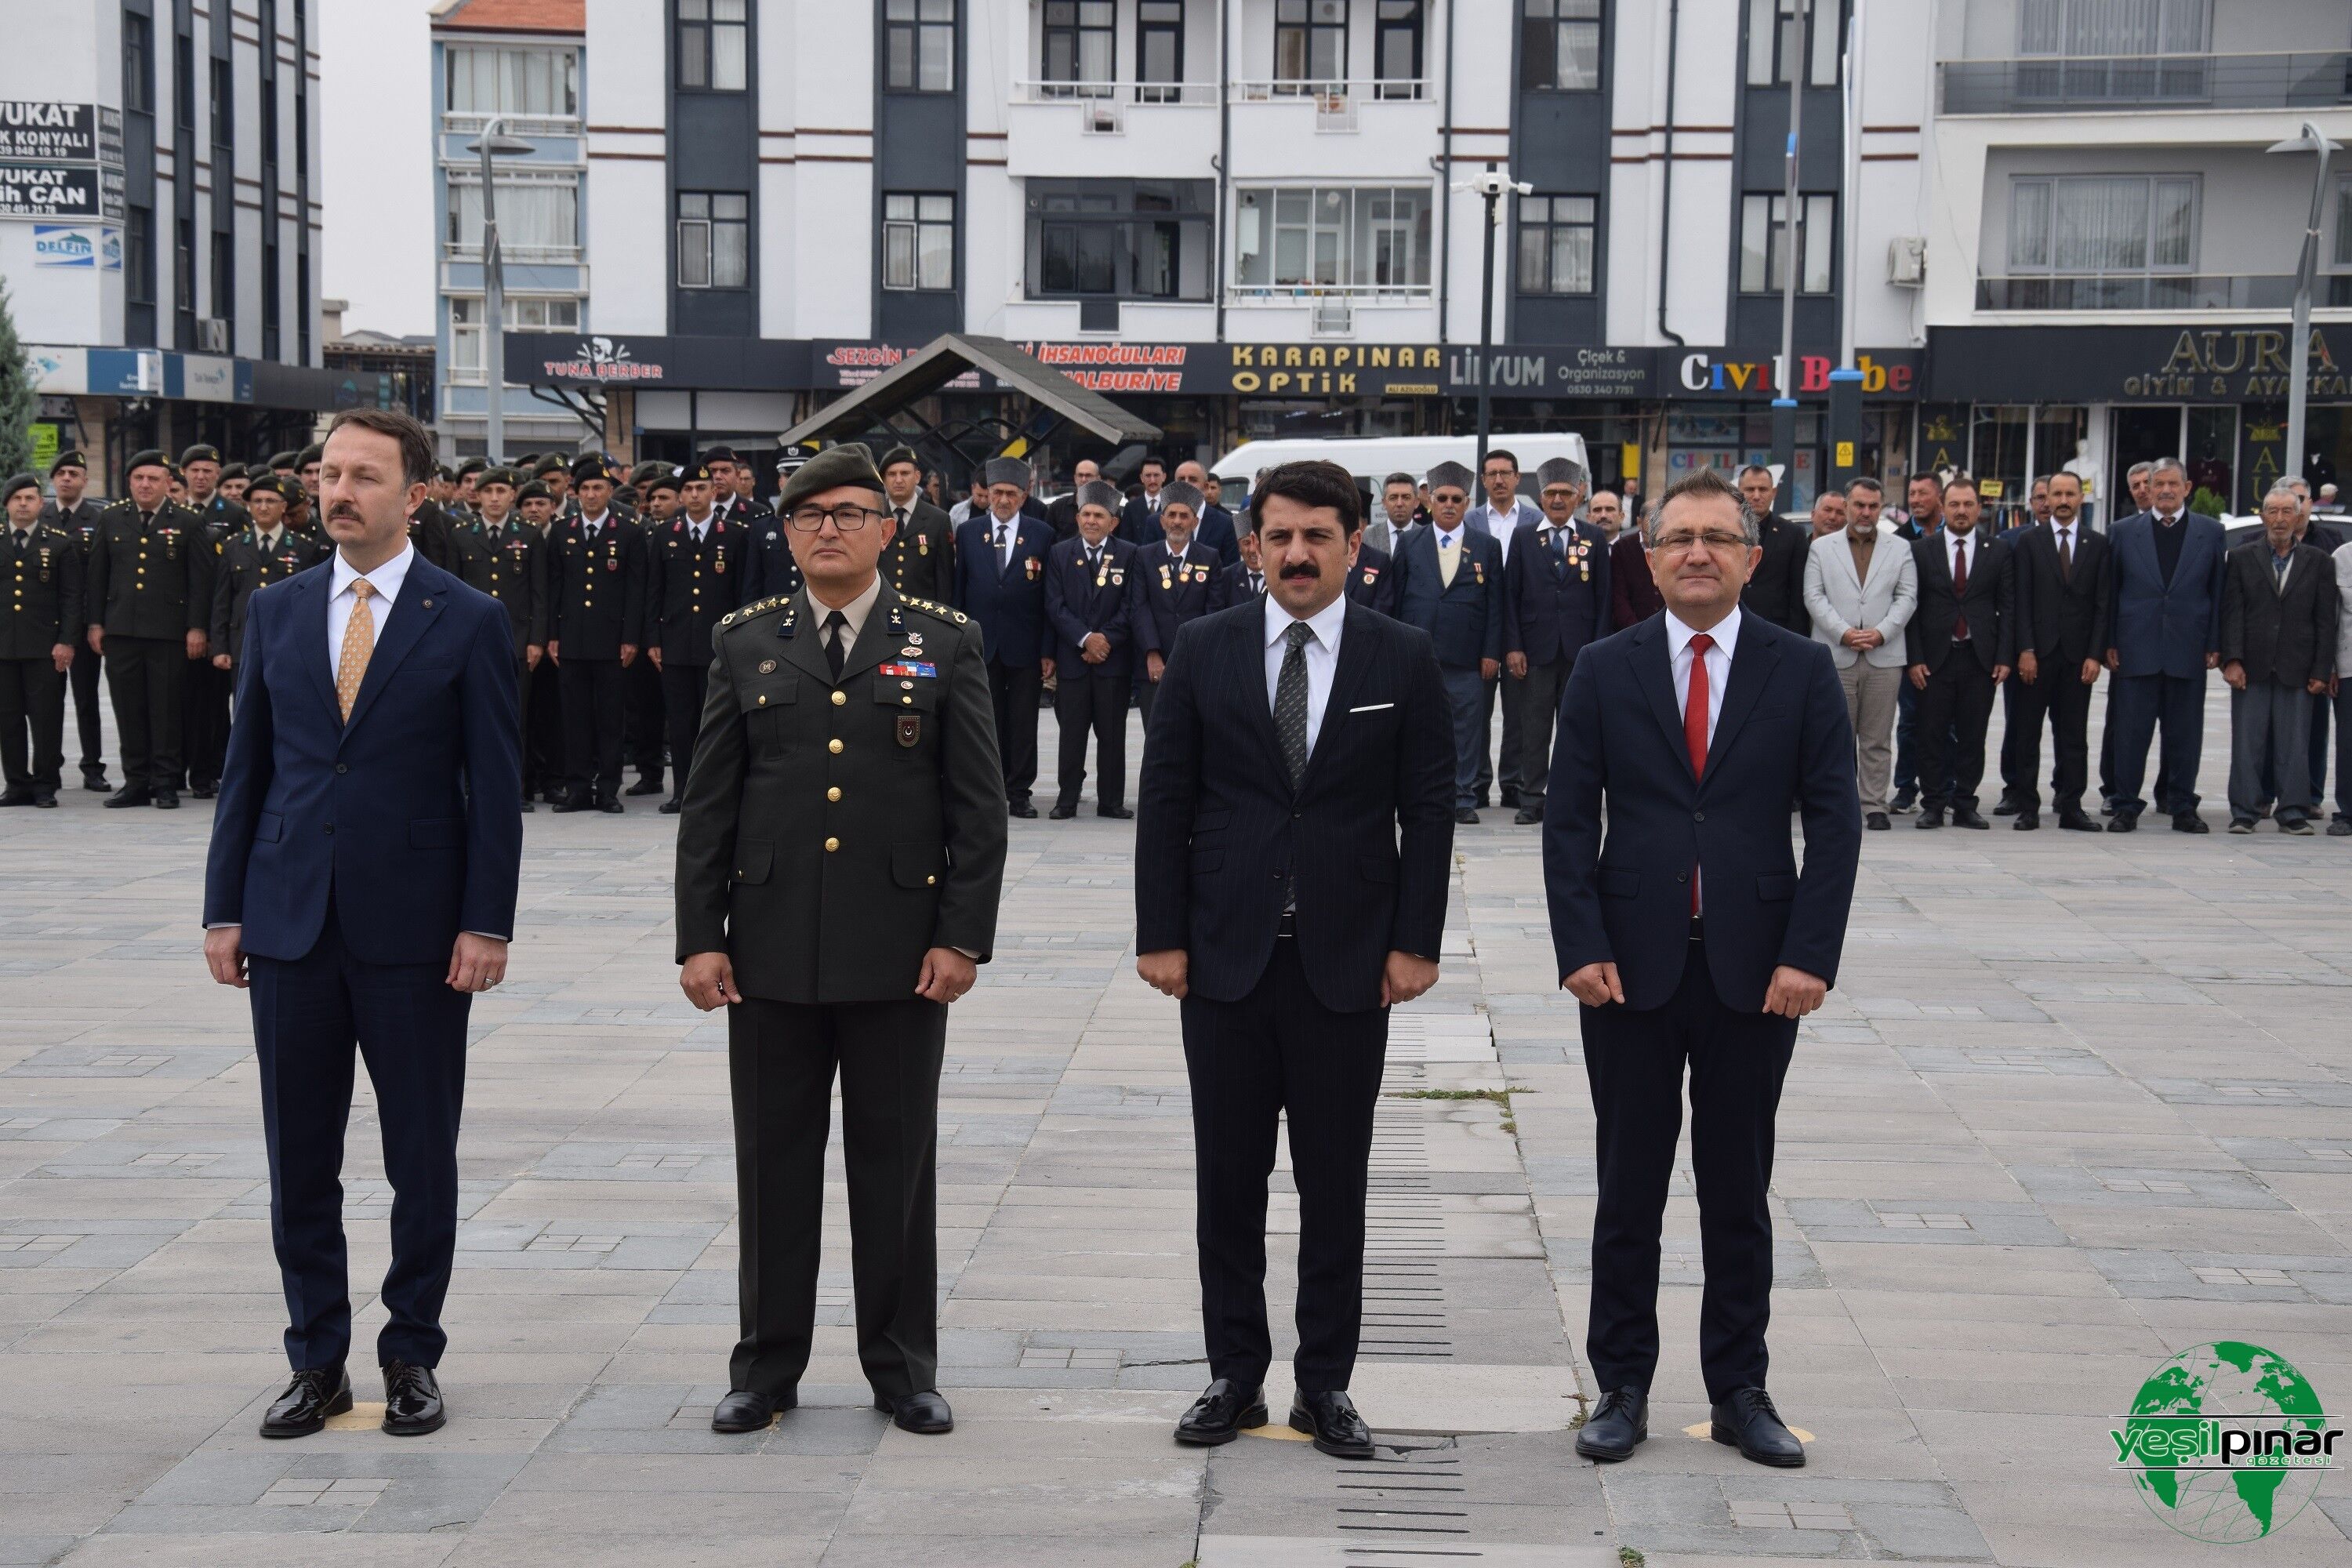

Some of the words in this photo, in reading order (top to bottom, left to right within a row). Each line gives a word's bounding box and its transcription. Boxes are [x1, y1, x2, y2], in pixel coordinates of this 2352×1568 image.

[16, 131, 89, 147] KONYALI
[29, 186, 85, 205] CAN
[1232, 347, 1440, 367] KARAPINAR
[1617, 349, 1626, 363] &
[2161, 329, 2339, 373] AURA
[544, 361, 593, 377] TUNA
[597, 363, 662, 379] BERBER
[1060, 368, 1182, 391] ALBURİYE
[1799, 355, 1913, 392] Bbe
[2211, 376, 2227, 395] &
